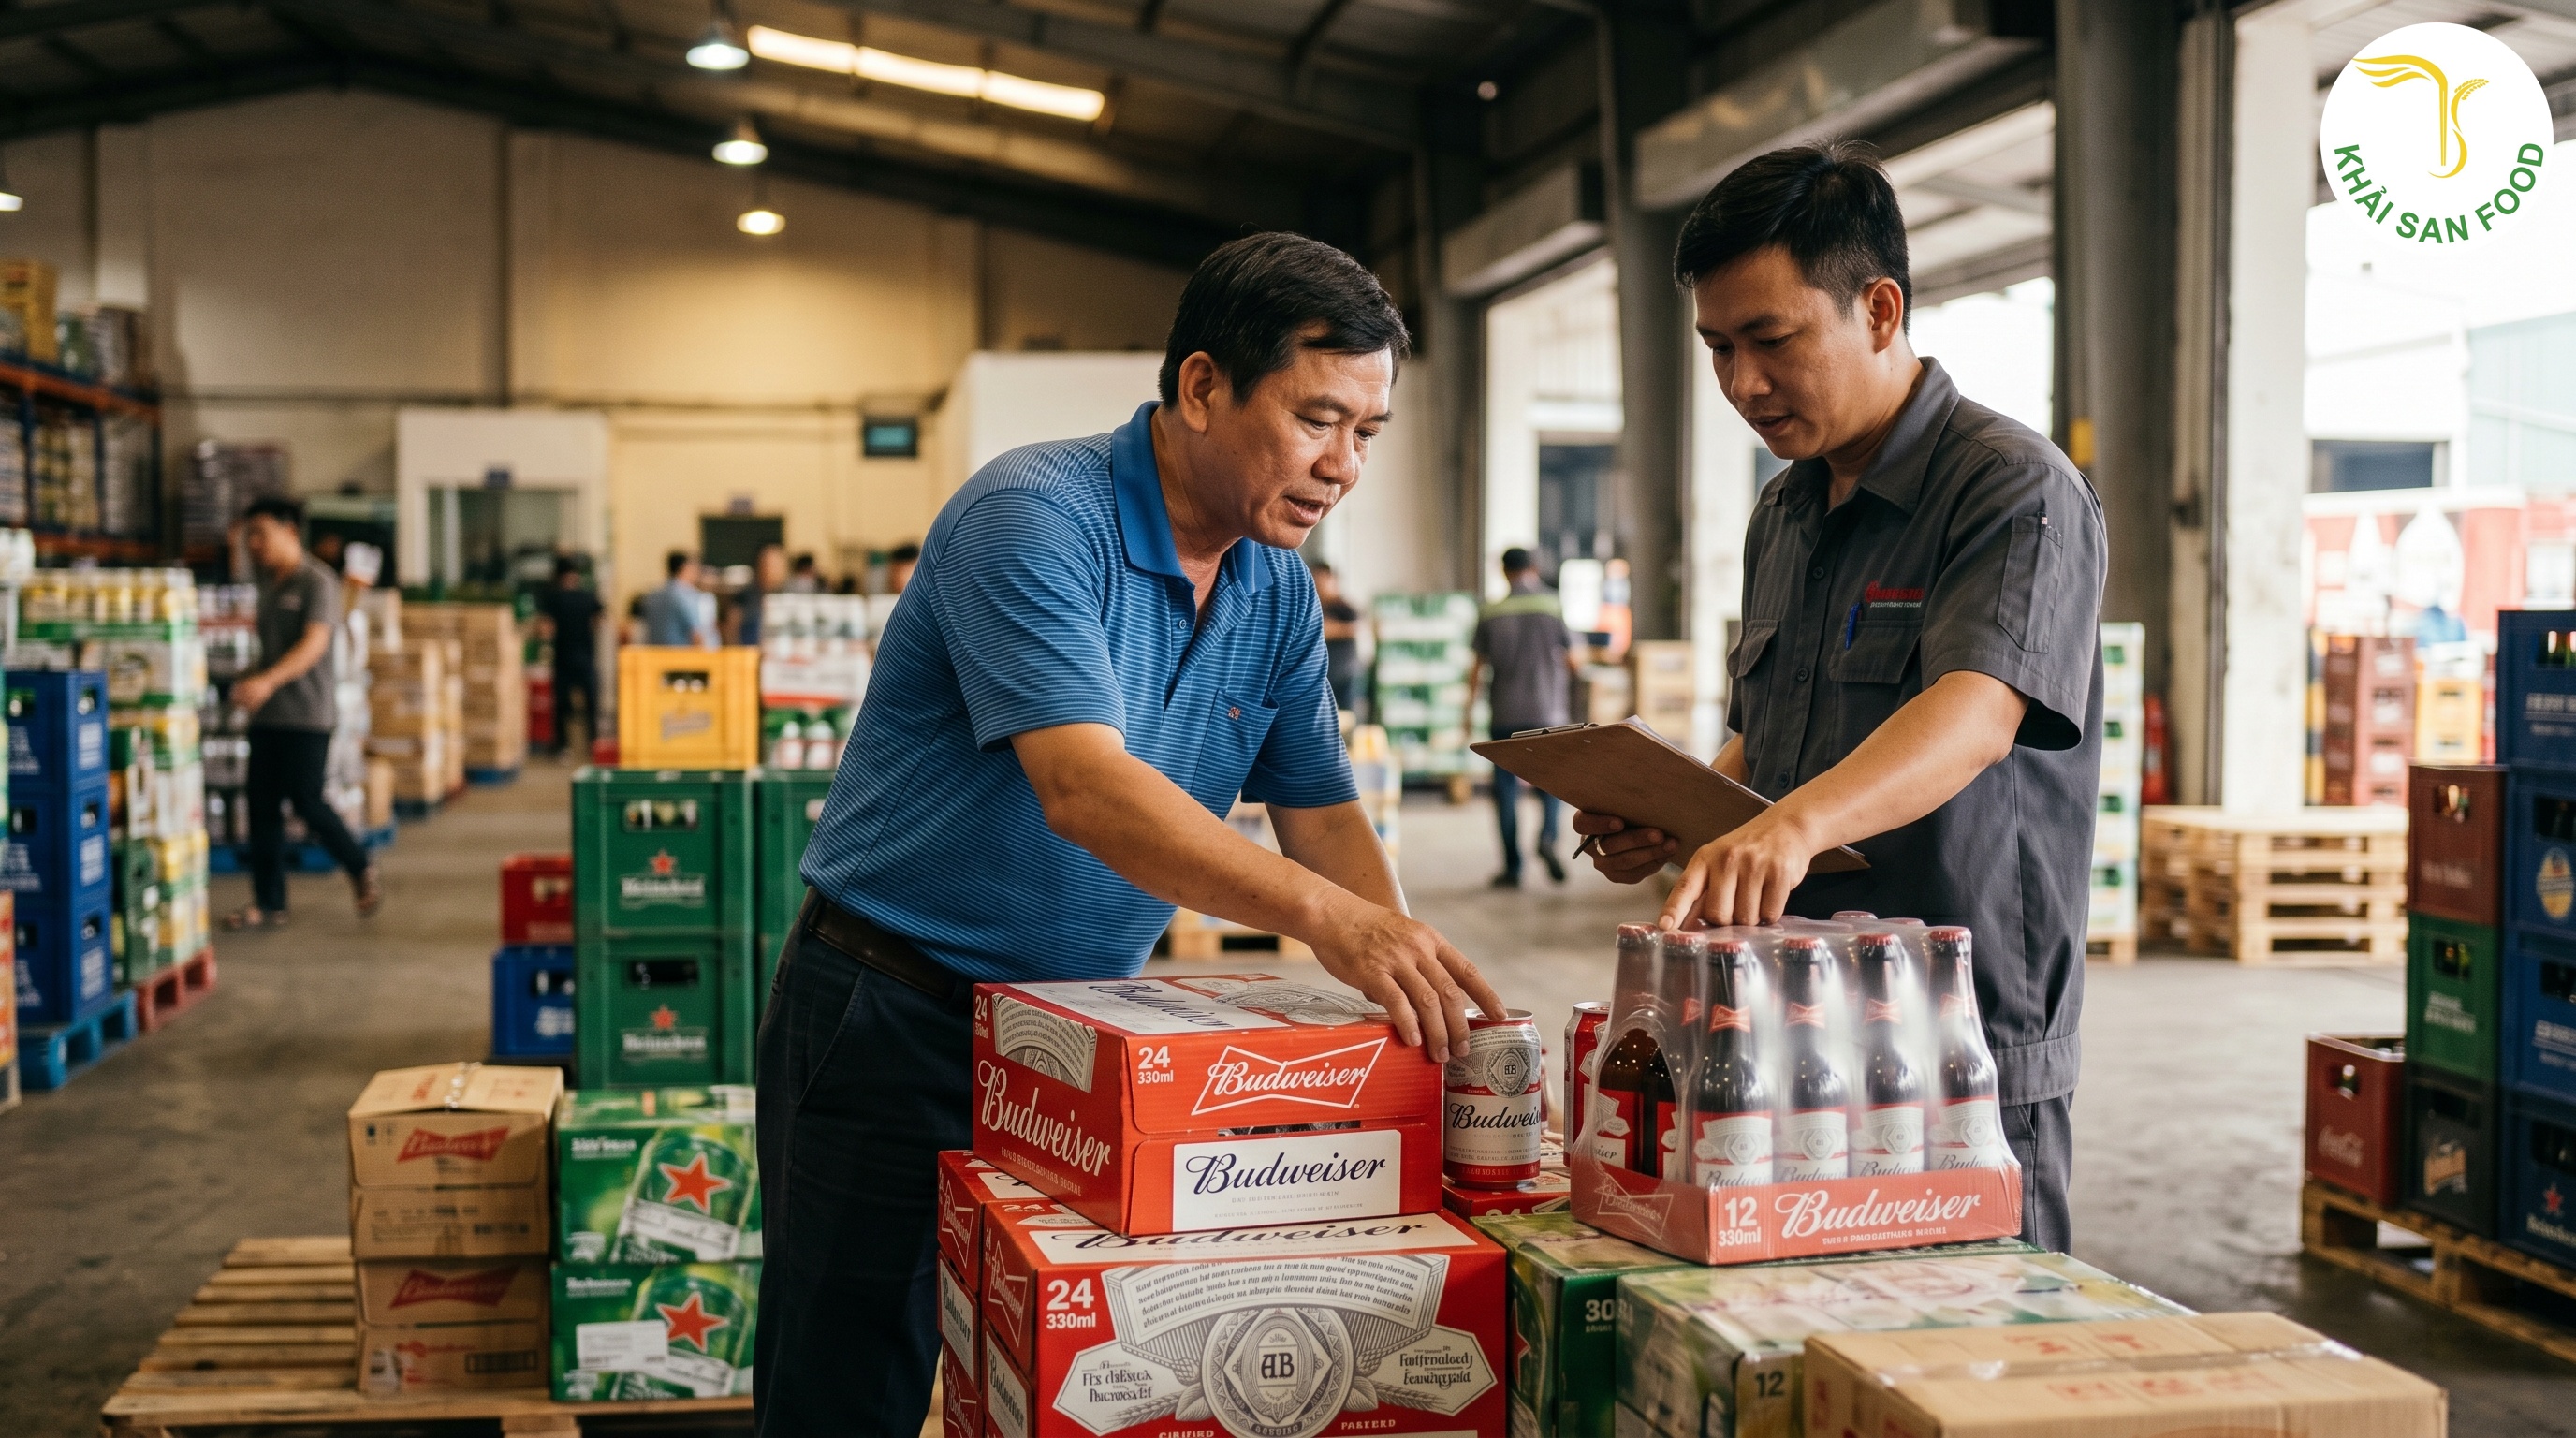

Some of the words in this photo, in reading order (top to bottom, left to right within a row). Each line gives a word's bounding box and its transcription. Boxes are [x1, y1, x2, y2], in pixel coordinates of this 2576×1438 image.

[975, 994, 988, 1022] 24
[1137, 1045, 1171, 1070] 24
[1137, 1070, 1174, 1084] 330ml
[1208, 1059, 1368, 1096] Budweiser
[978, 1060, 1111, 1177] Budweiser
[1185, 1152, 1386, 1196] Budweiser
[1725, 1196, 1758, 1228] 12
[1775, 1188, 1982, 1239] Budweiser
[1051, 1222, 1428, 1250] Budweiser
[1718, 1227, 1762, 1247] 330ml
[1046, 1278, 1094, 1311] 24
[1046, 1313, 1096, 1330] 330ml
[1585, 1299, 1616, 1322] 30
[1261, 1352, 1295, 1379] AB
[1755, 1370, 1785, 1398] 12
